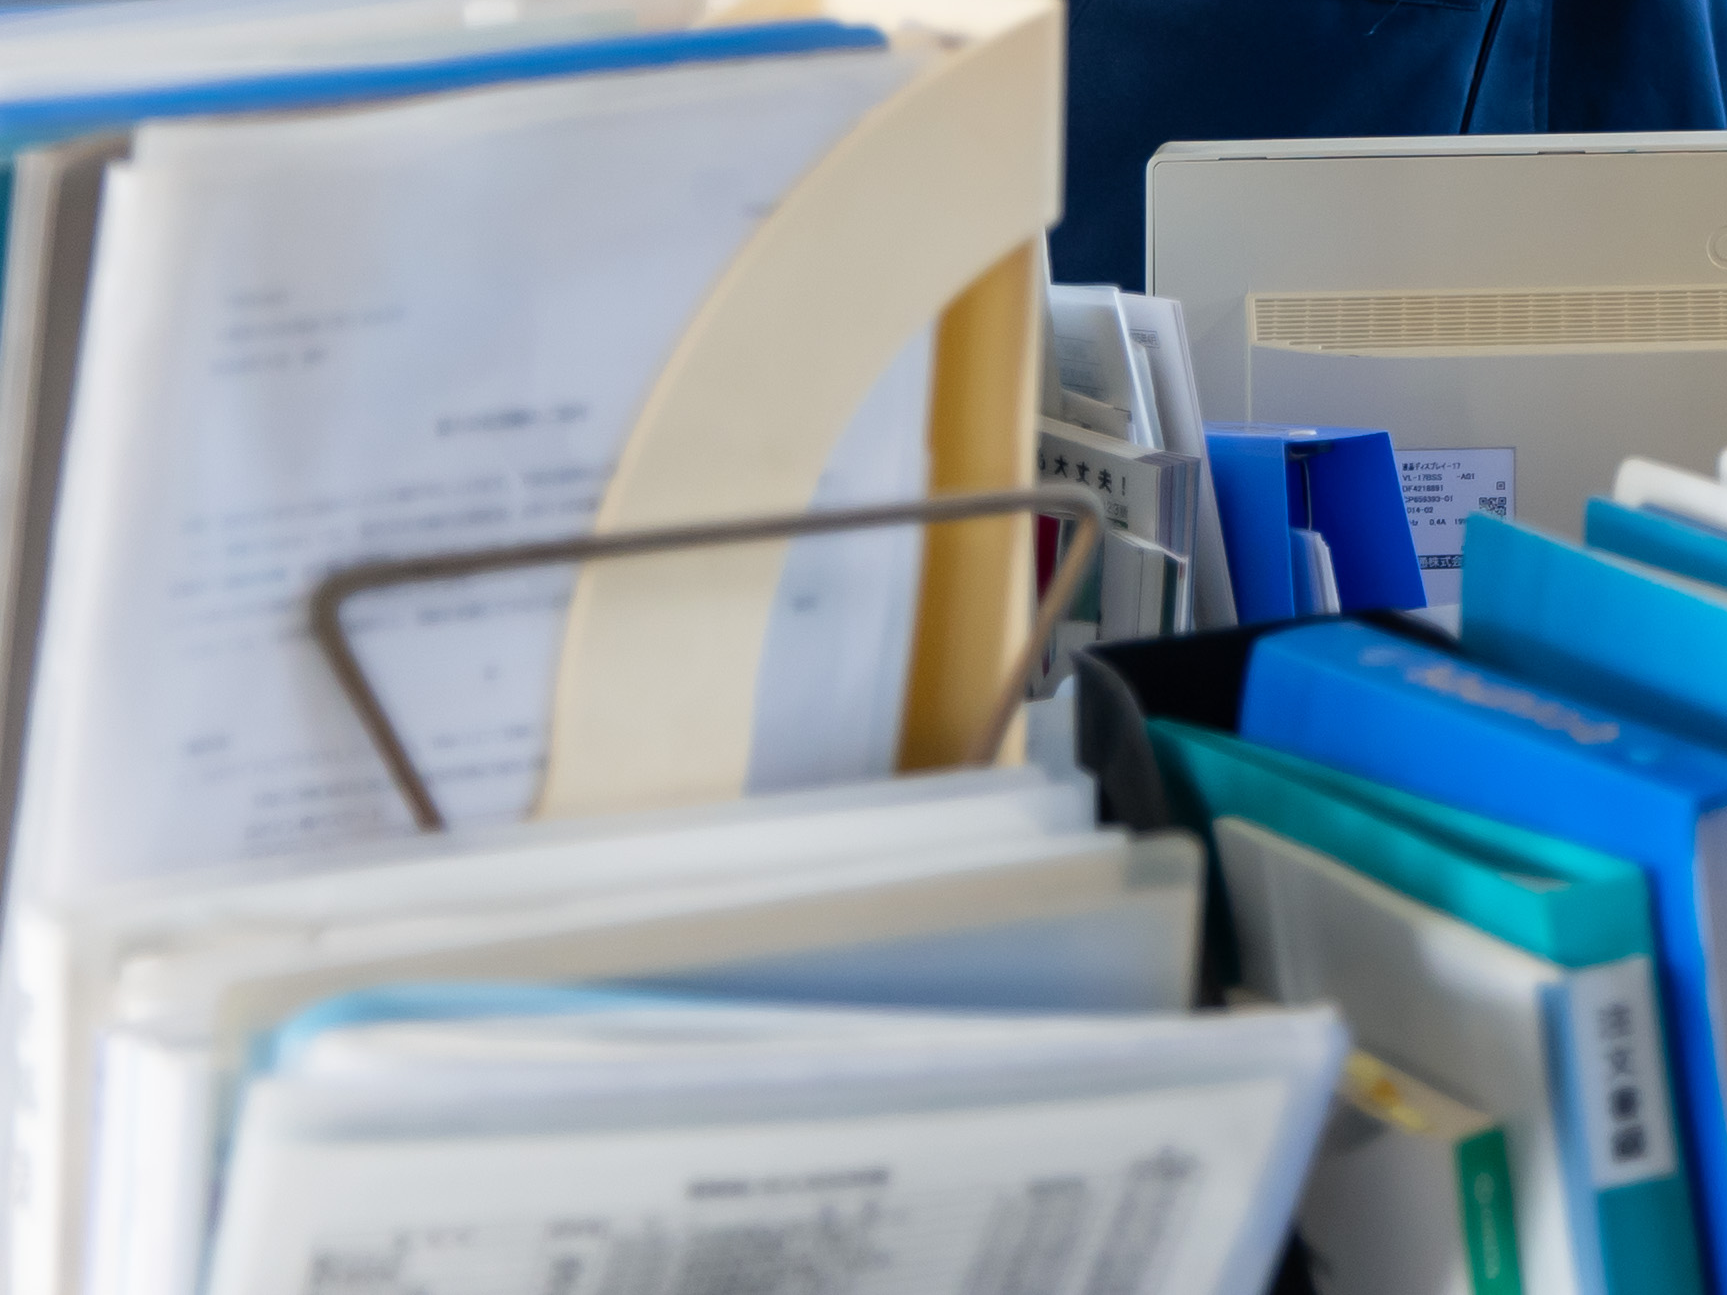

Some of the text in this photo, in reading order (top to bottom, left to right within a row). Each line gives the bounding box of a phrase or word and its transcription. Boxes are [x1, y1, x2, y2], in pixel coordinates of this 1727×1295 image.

[1406, 506, 1434, 514] 014-02
[1419, 555, 1463, 568] 通株式会
